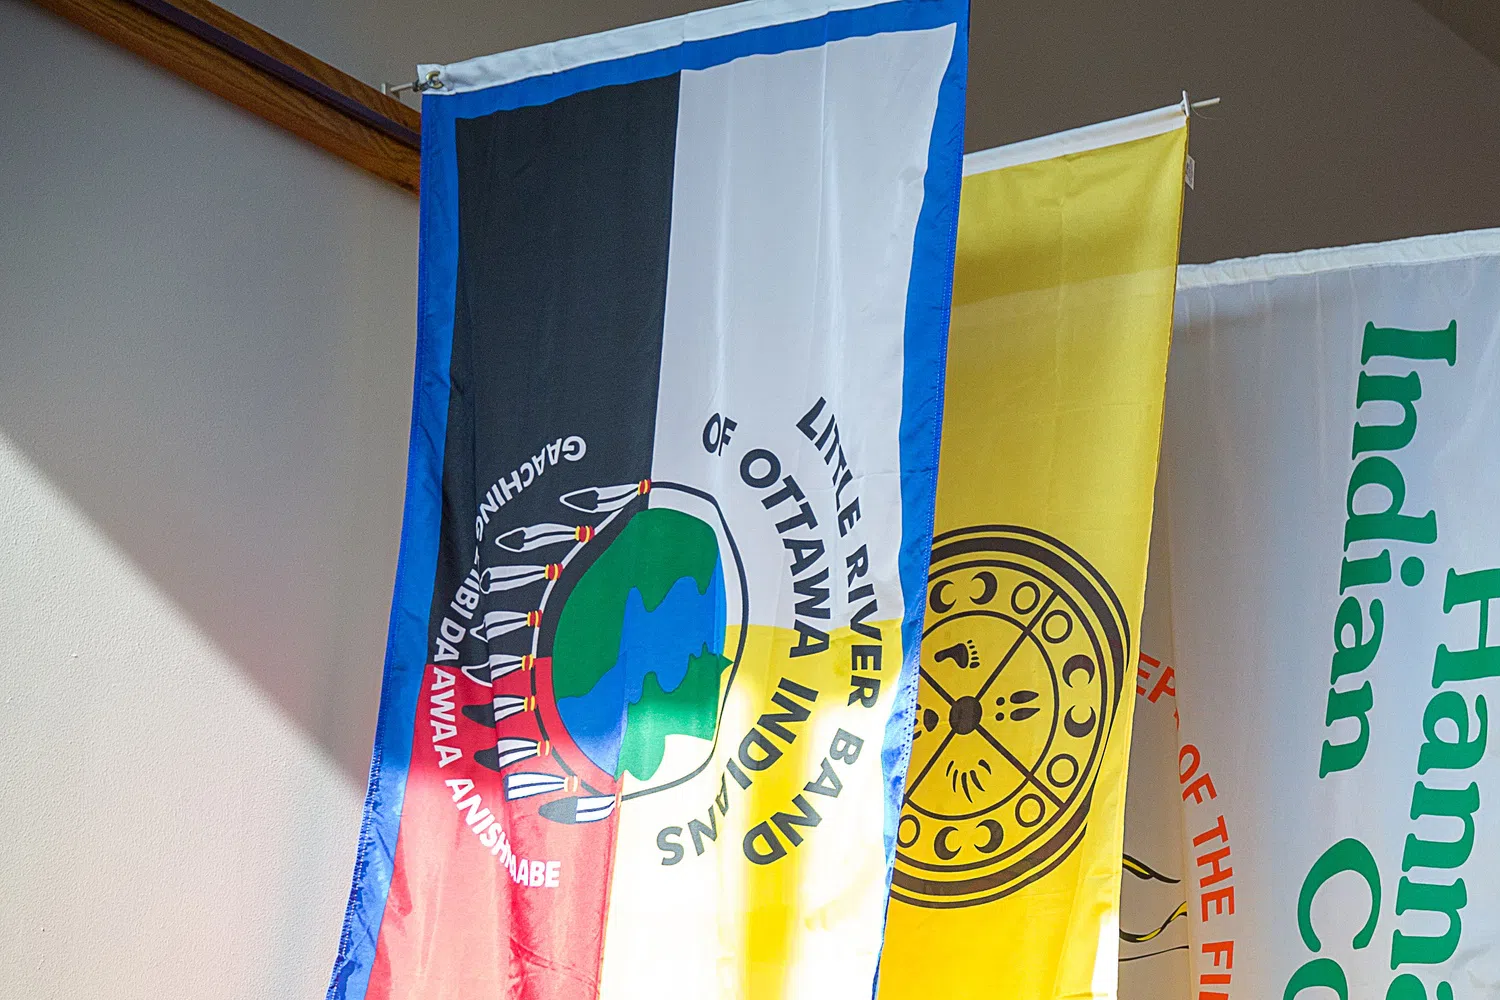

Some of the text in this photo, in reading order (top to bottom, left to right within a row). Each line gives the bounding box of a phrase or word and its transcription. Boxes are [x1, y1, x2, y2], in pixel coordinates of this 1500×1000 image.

[475, 436, 587, 542] GAACHING
[1319, 319, 1458, 779] Indian
[656, 412, 831, 866] OF OTTAWA INDIANS
[742, 397, 882, 866] LITTLE RIVER BAND
[1176, 744, 1216, 804] OF
[1190, 813, 1236, 922] THE
